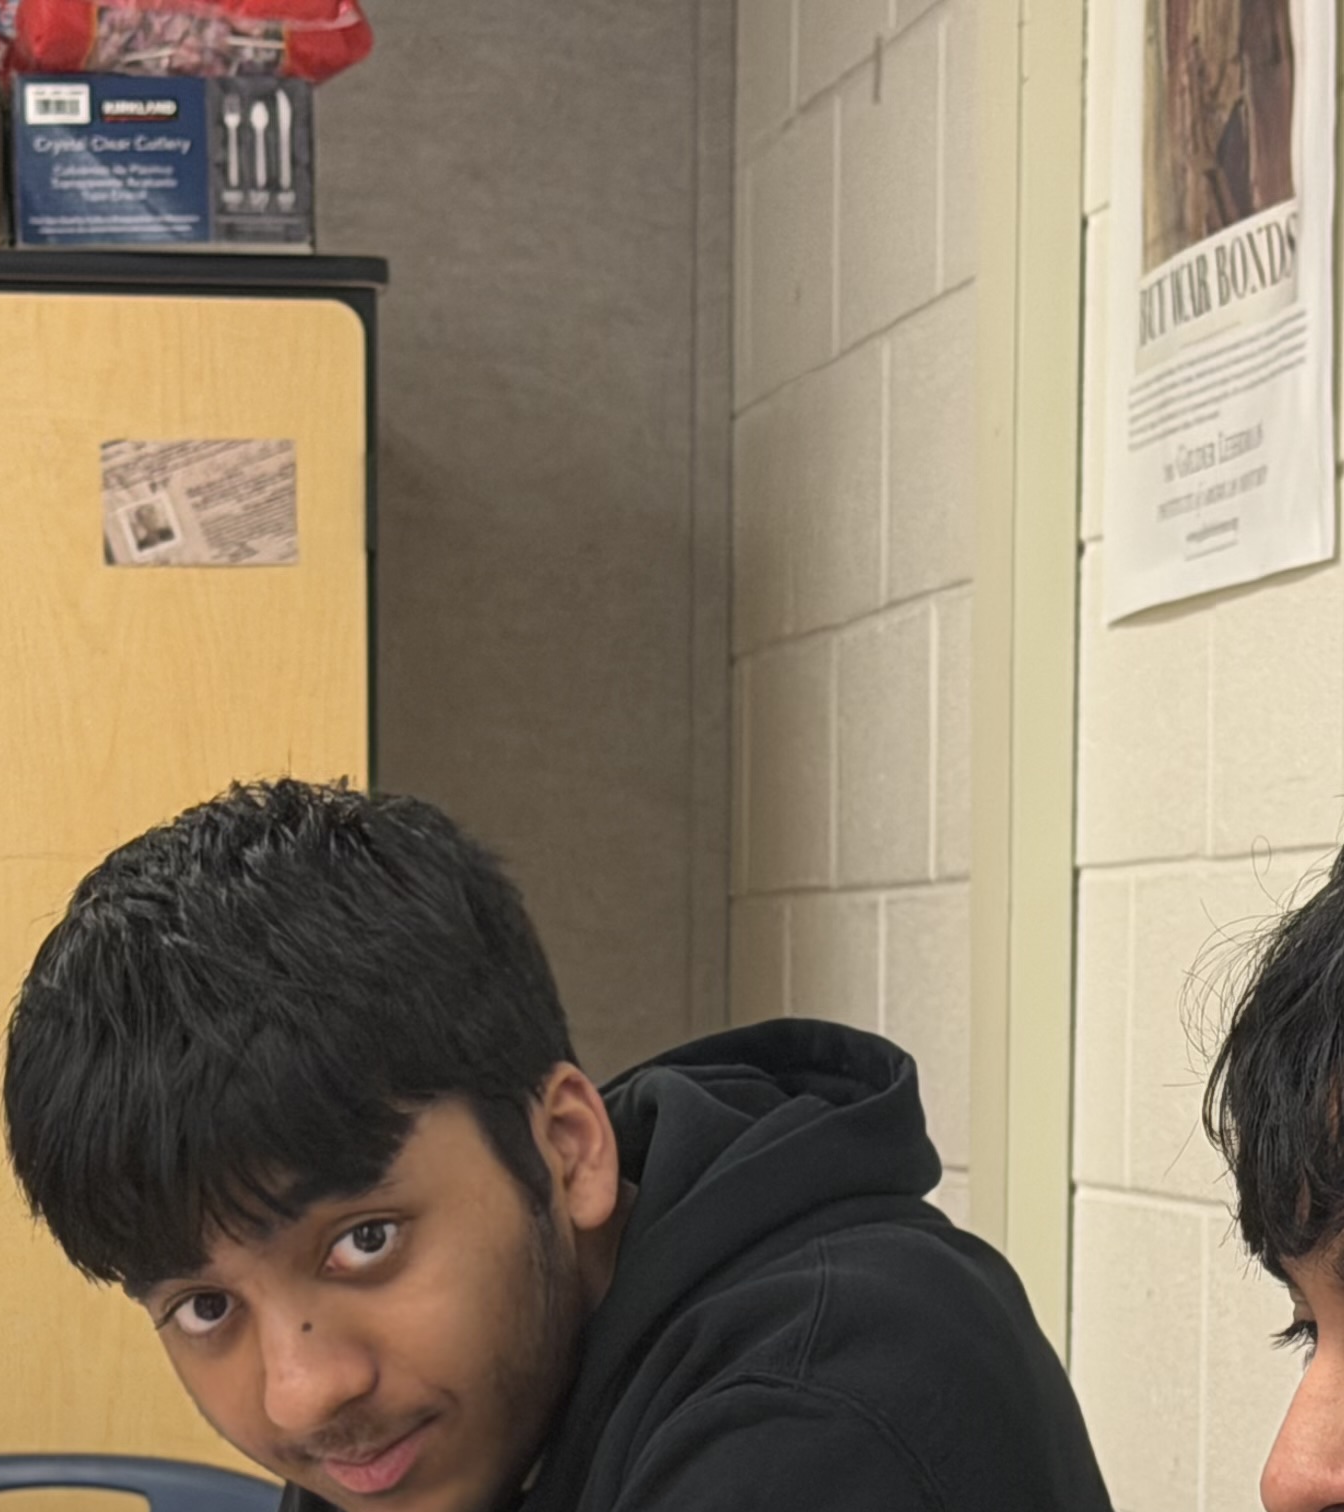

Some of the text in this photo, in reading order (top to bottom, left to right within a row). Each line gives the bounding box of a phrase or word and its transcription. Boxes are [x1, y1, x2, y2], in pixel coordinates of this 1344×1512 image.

[101, 99, 177, 117] KIRKLAND
[134, 135, 192, 156] Cutlery
[1214, 211, 1298, 308] BONDS
